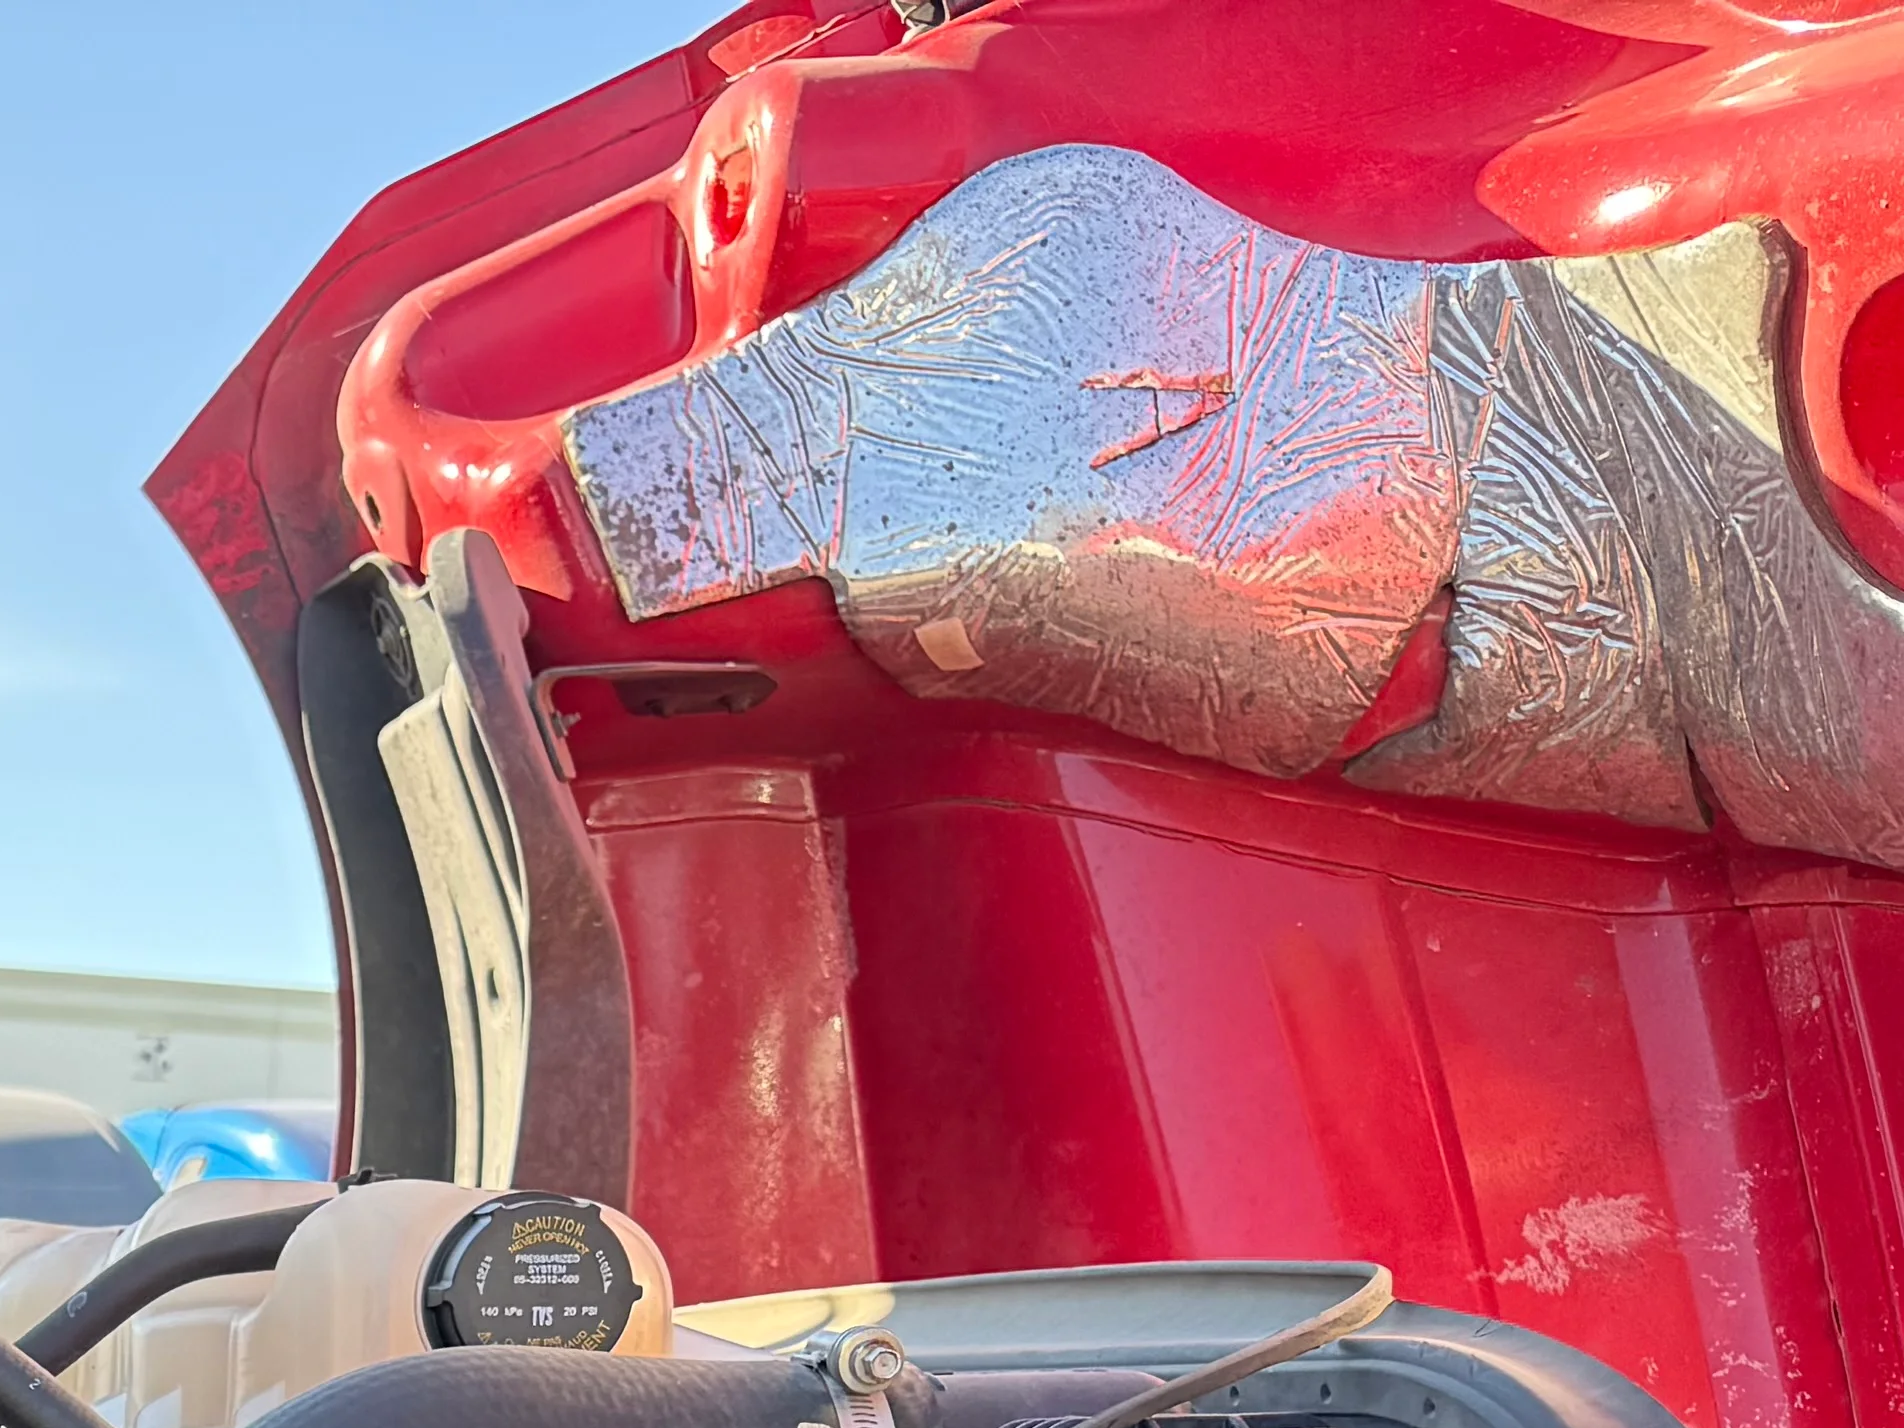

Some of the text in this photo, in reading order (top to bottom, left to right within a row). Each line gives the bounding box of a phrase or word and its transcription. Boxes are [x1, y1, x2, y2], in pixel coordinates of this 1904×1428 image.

[525, 1216, 585, 1236] CAUTION
[515, 1254, 580, 1264] PRESSURIZED
[528, 1265, 566, 1274] SYSTEM
[532, 1306, 554, 1326] TVS
[563, 1307, 598, 1317] 20 PSI
[28, 1378, 41, 1390] 2
